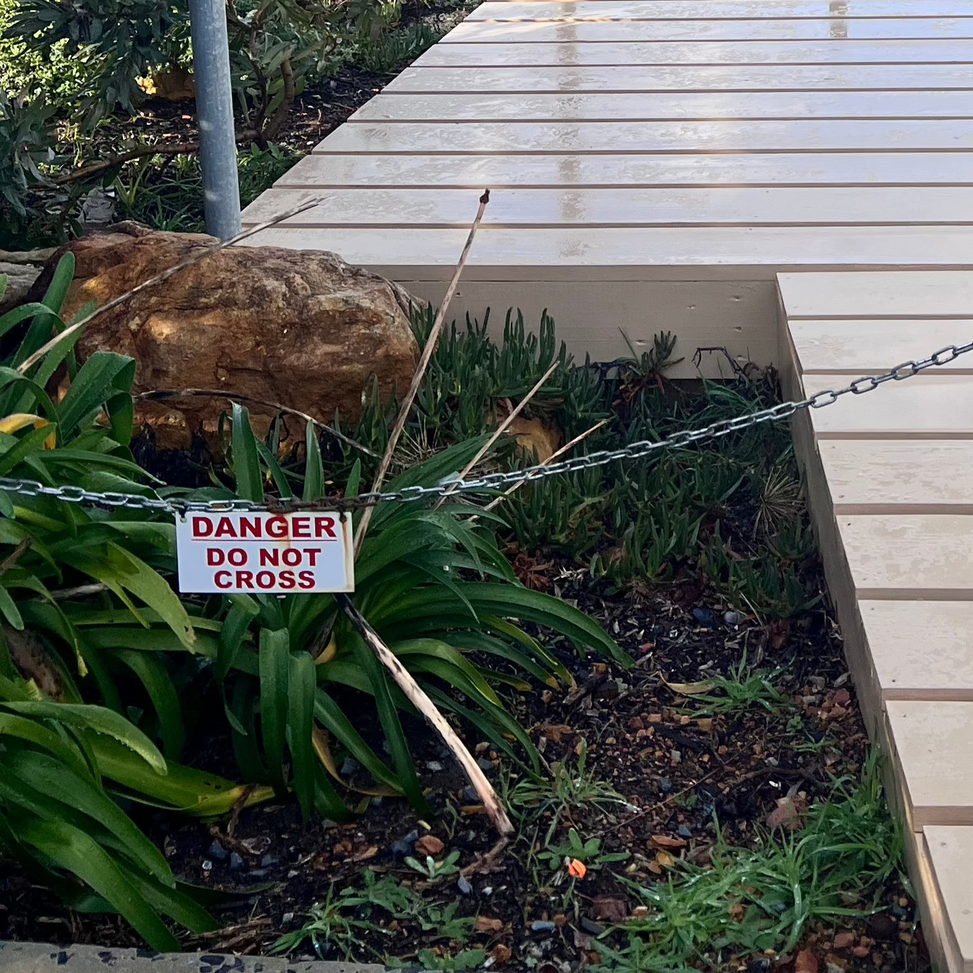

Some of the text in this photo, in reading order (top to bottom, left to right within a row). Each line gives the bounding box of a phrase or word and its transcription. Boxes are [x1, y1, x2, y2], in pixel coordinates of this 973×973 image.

[192, 516, 336, 538] DANGER
[206, 548, 322, 567] DO NOT
[214, 570, 316, 589] CROSS
